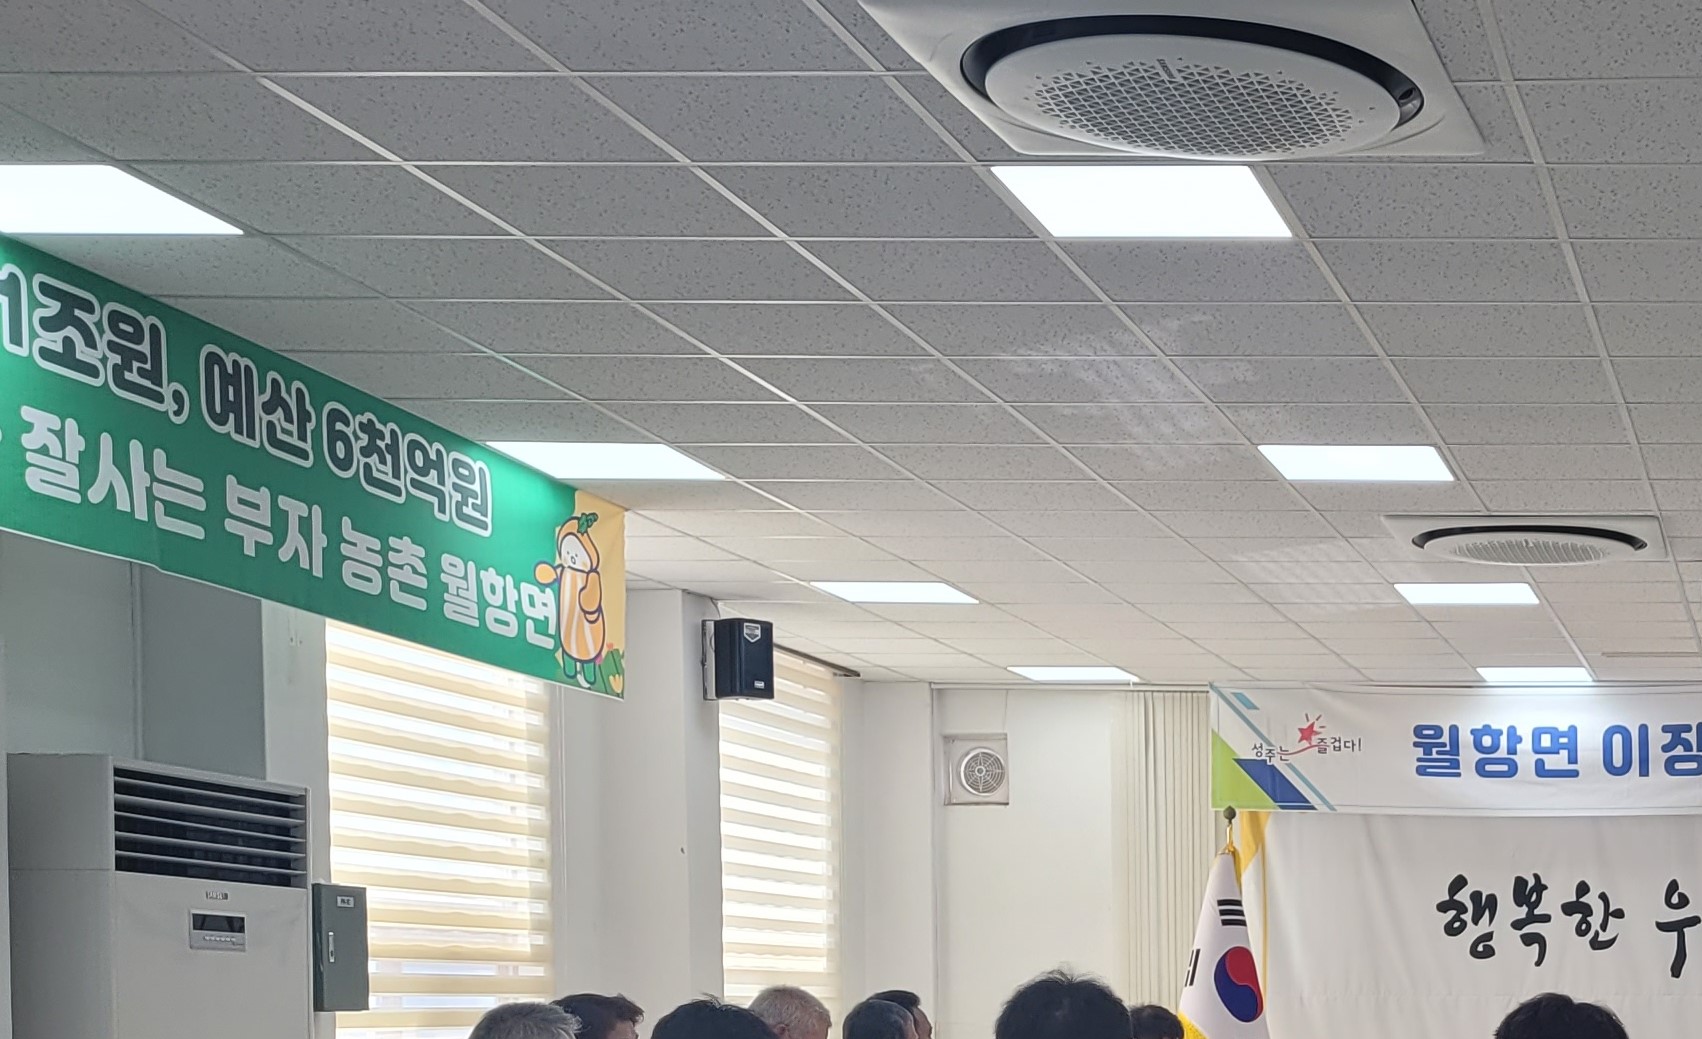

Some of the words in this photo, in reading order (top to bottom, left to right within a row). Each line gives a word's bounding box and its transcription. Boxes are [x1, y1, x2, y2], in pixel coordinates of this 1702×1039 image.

[201, 344, 316, 468] 예산
[323, 401, 493, 537] 6천억원
[20, 405, 206, 540] 잘사는
[224, 474, 327, 578] 부자
[339, 516, 428, 610] 농촌
[440, 553, 557, 650] 월항면
[1251, 743, 1290, 763] 성주는
[1316, 736, 1362, 755] 즐겁다!
[1412, 722, 1581, 779] 월항면
[1436, 873, 1625, 967] 행복한
